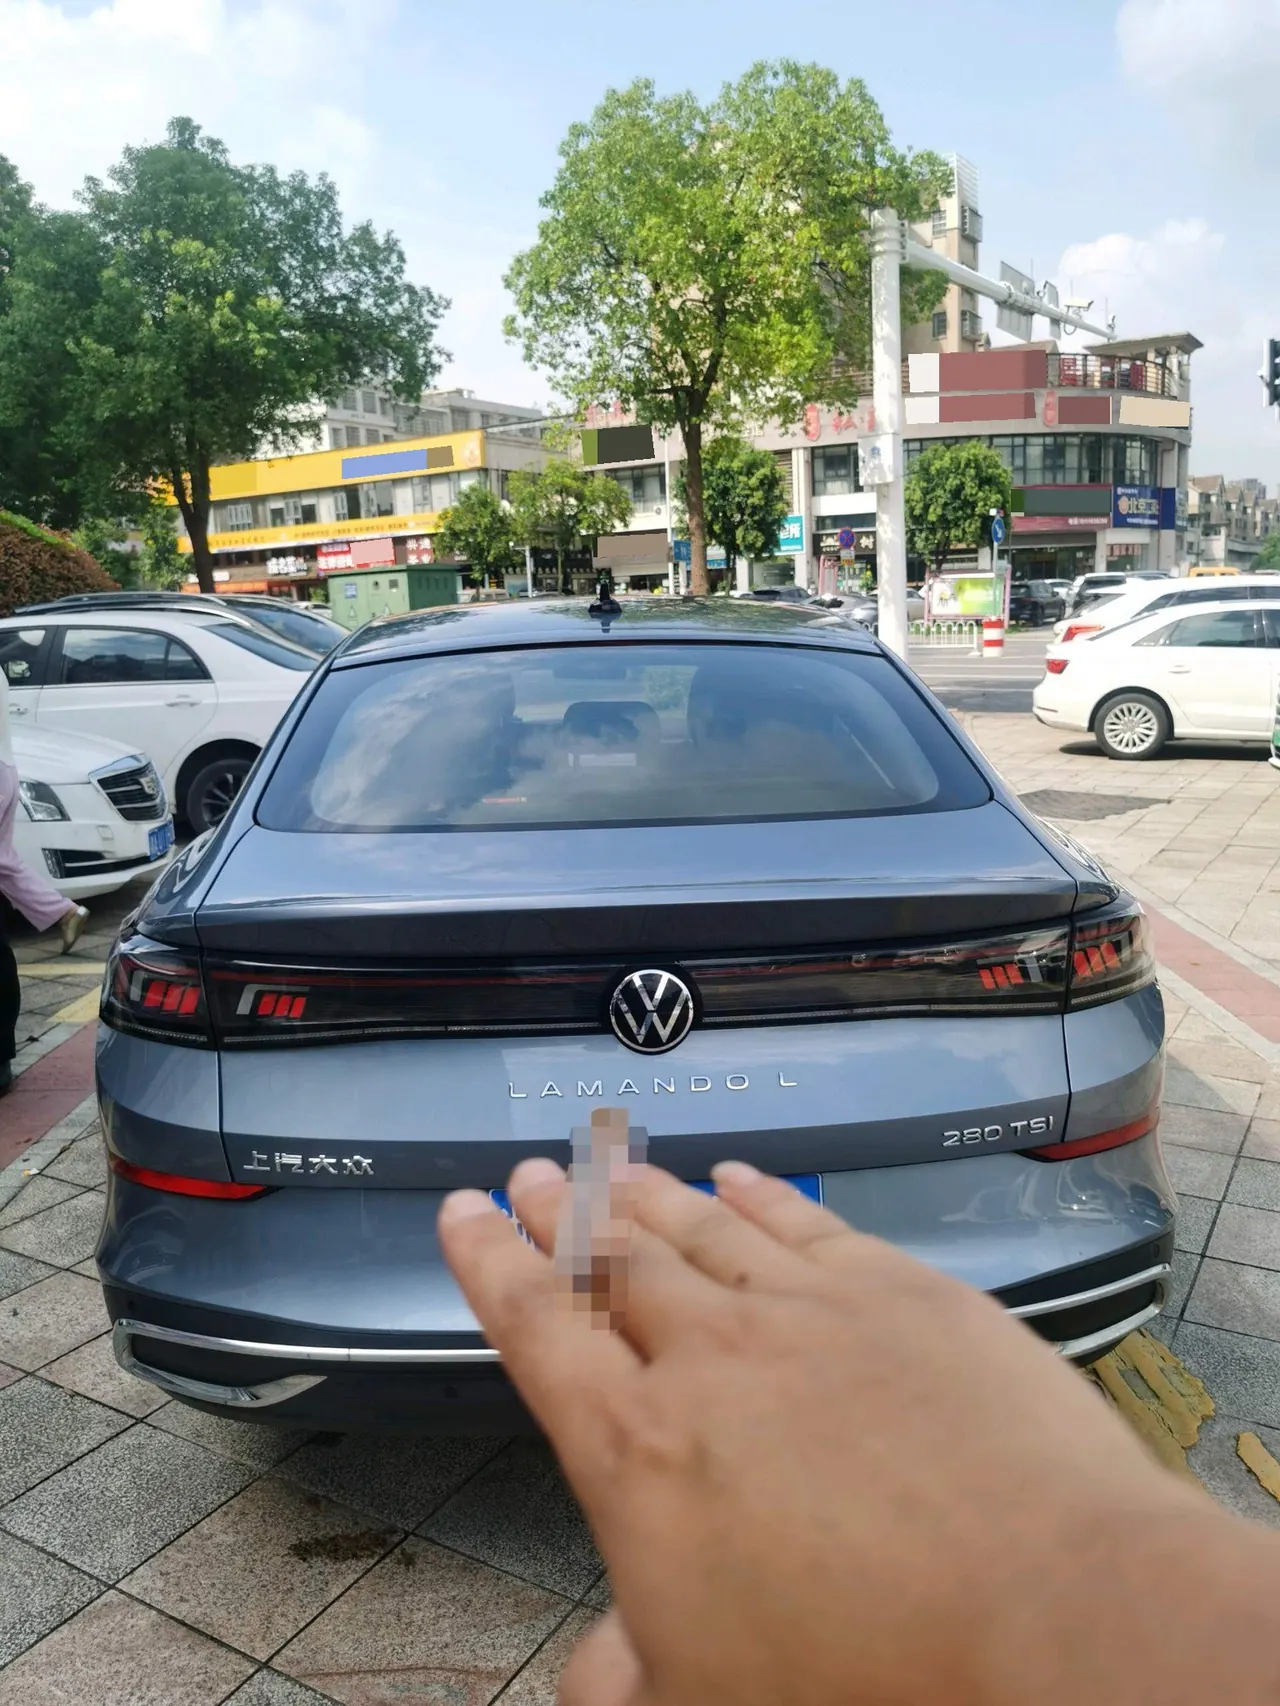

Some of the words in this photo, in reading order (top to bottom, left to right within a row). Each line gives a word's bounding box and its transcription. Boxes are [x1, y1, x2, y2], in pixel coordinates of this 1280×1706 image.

[509, 1073, 749, 1098] LAMANDO
[778, 1071, 797, 1087] L
[942, 1125, 1003, 1147] 280
[1009, 1115, 1054, 1137] TSI
[243, 1150, 374, 1175] 上汽大众
